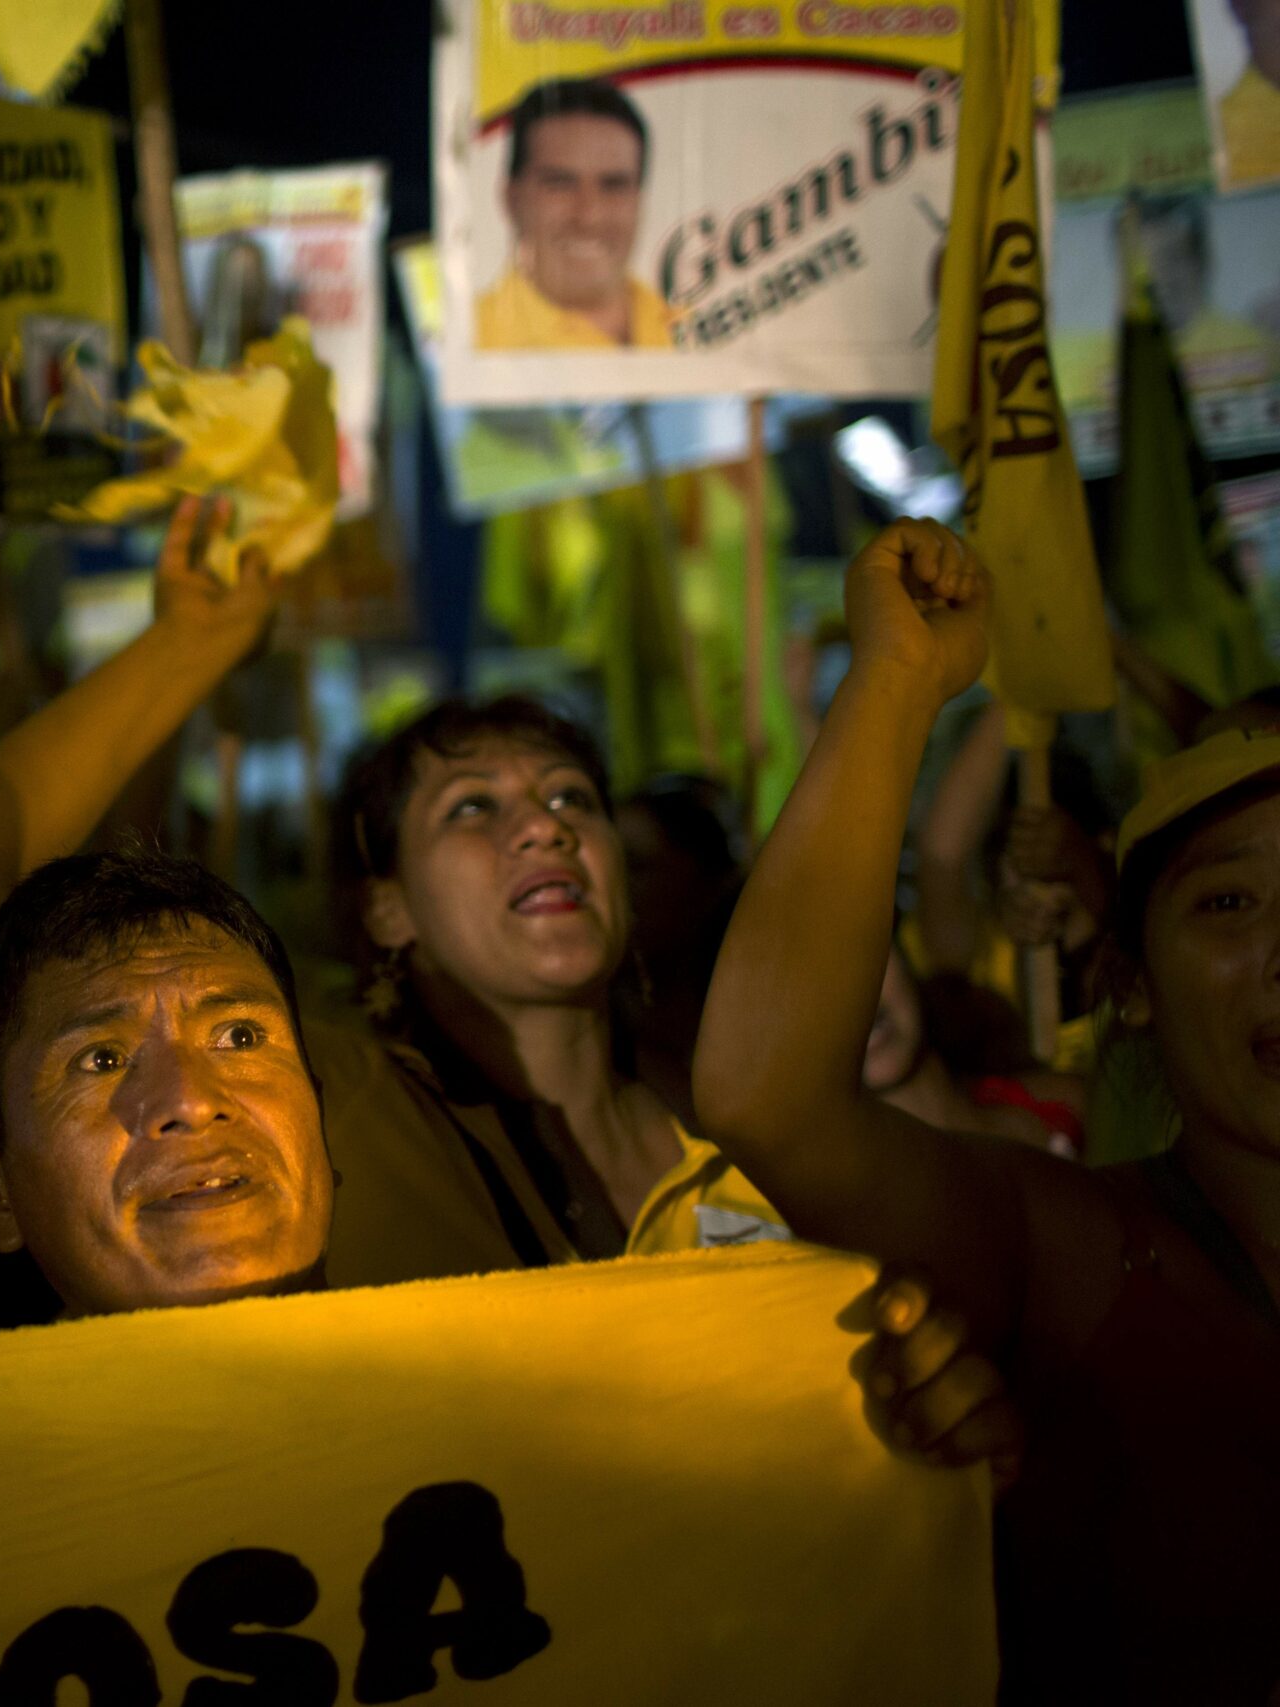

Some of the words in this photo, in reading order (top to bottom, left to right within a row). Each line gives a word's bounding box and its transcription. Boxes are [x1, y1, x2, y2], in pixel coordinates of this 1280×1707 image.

[720, 7, 780, 38] es
[795, 0, 963, 38] Cacao
[23, 196, 52, 238] Y
[658, 68, 960, 306] Gambi
[978, 220, 1060, 458] SOSA
